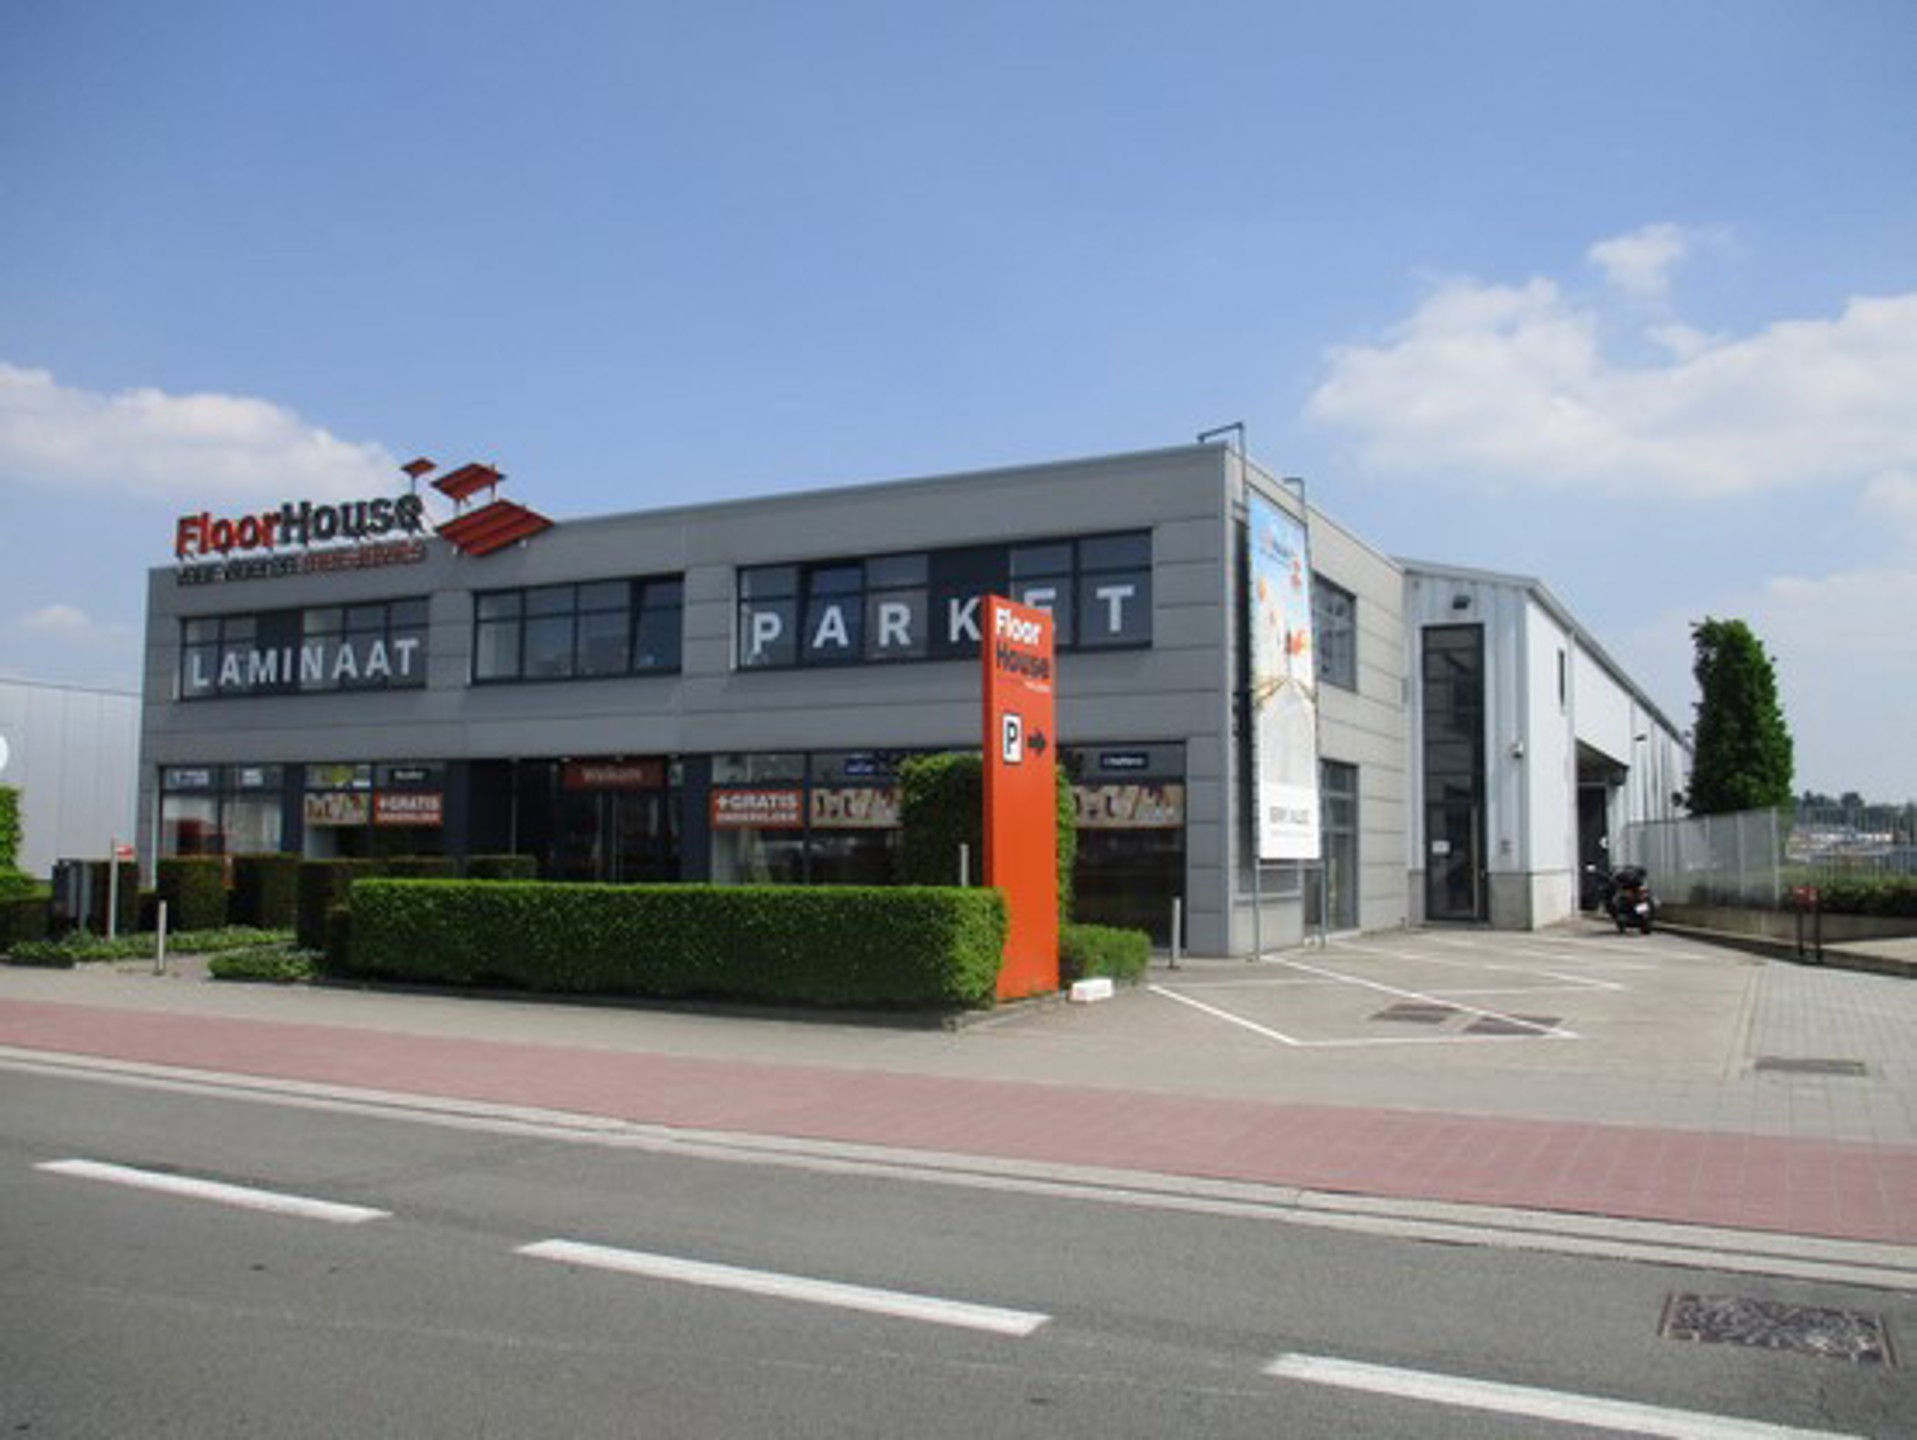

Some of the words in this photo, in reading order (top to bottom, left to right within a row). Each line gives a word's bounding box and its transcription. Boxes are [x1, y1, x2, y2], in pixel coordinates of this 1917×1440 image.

[176, 493, 424, 555] FloorHouse
[996, 608, 1041, 645] Floor
[192, 638, 418, 687] LAMINAAT
[996, 641, 1050, 679] House
[1006, 721, 1018, 755] P
